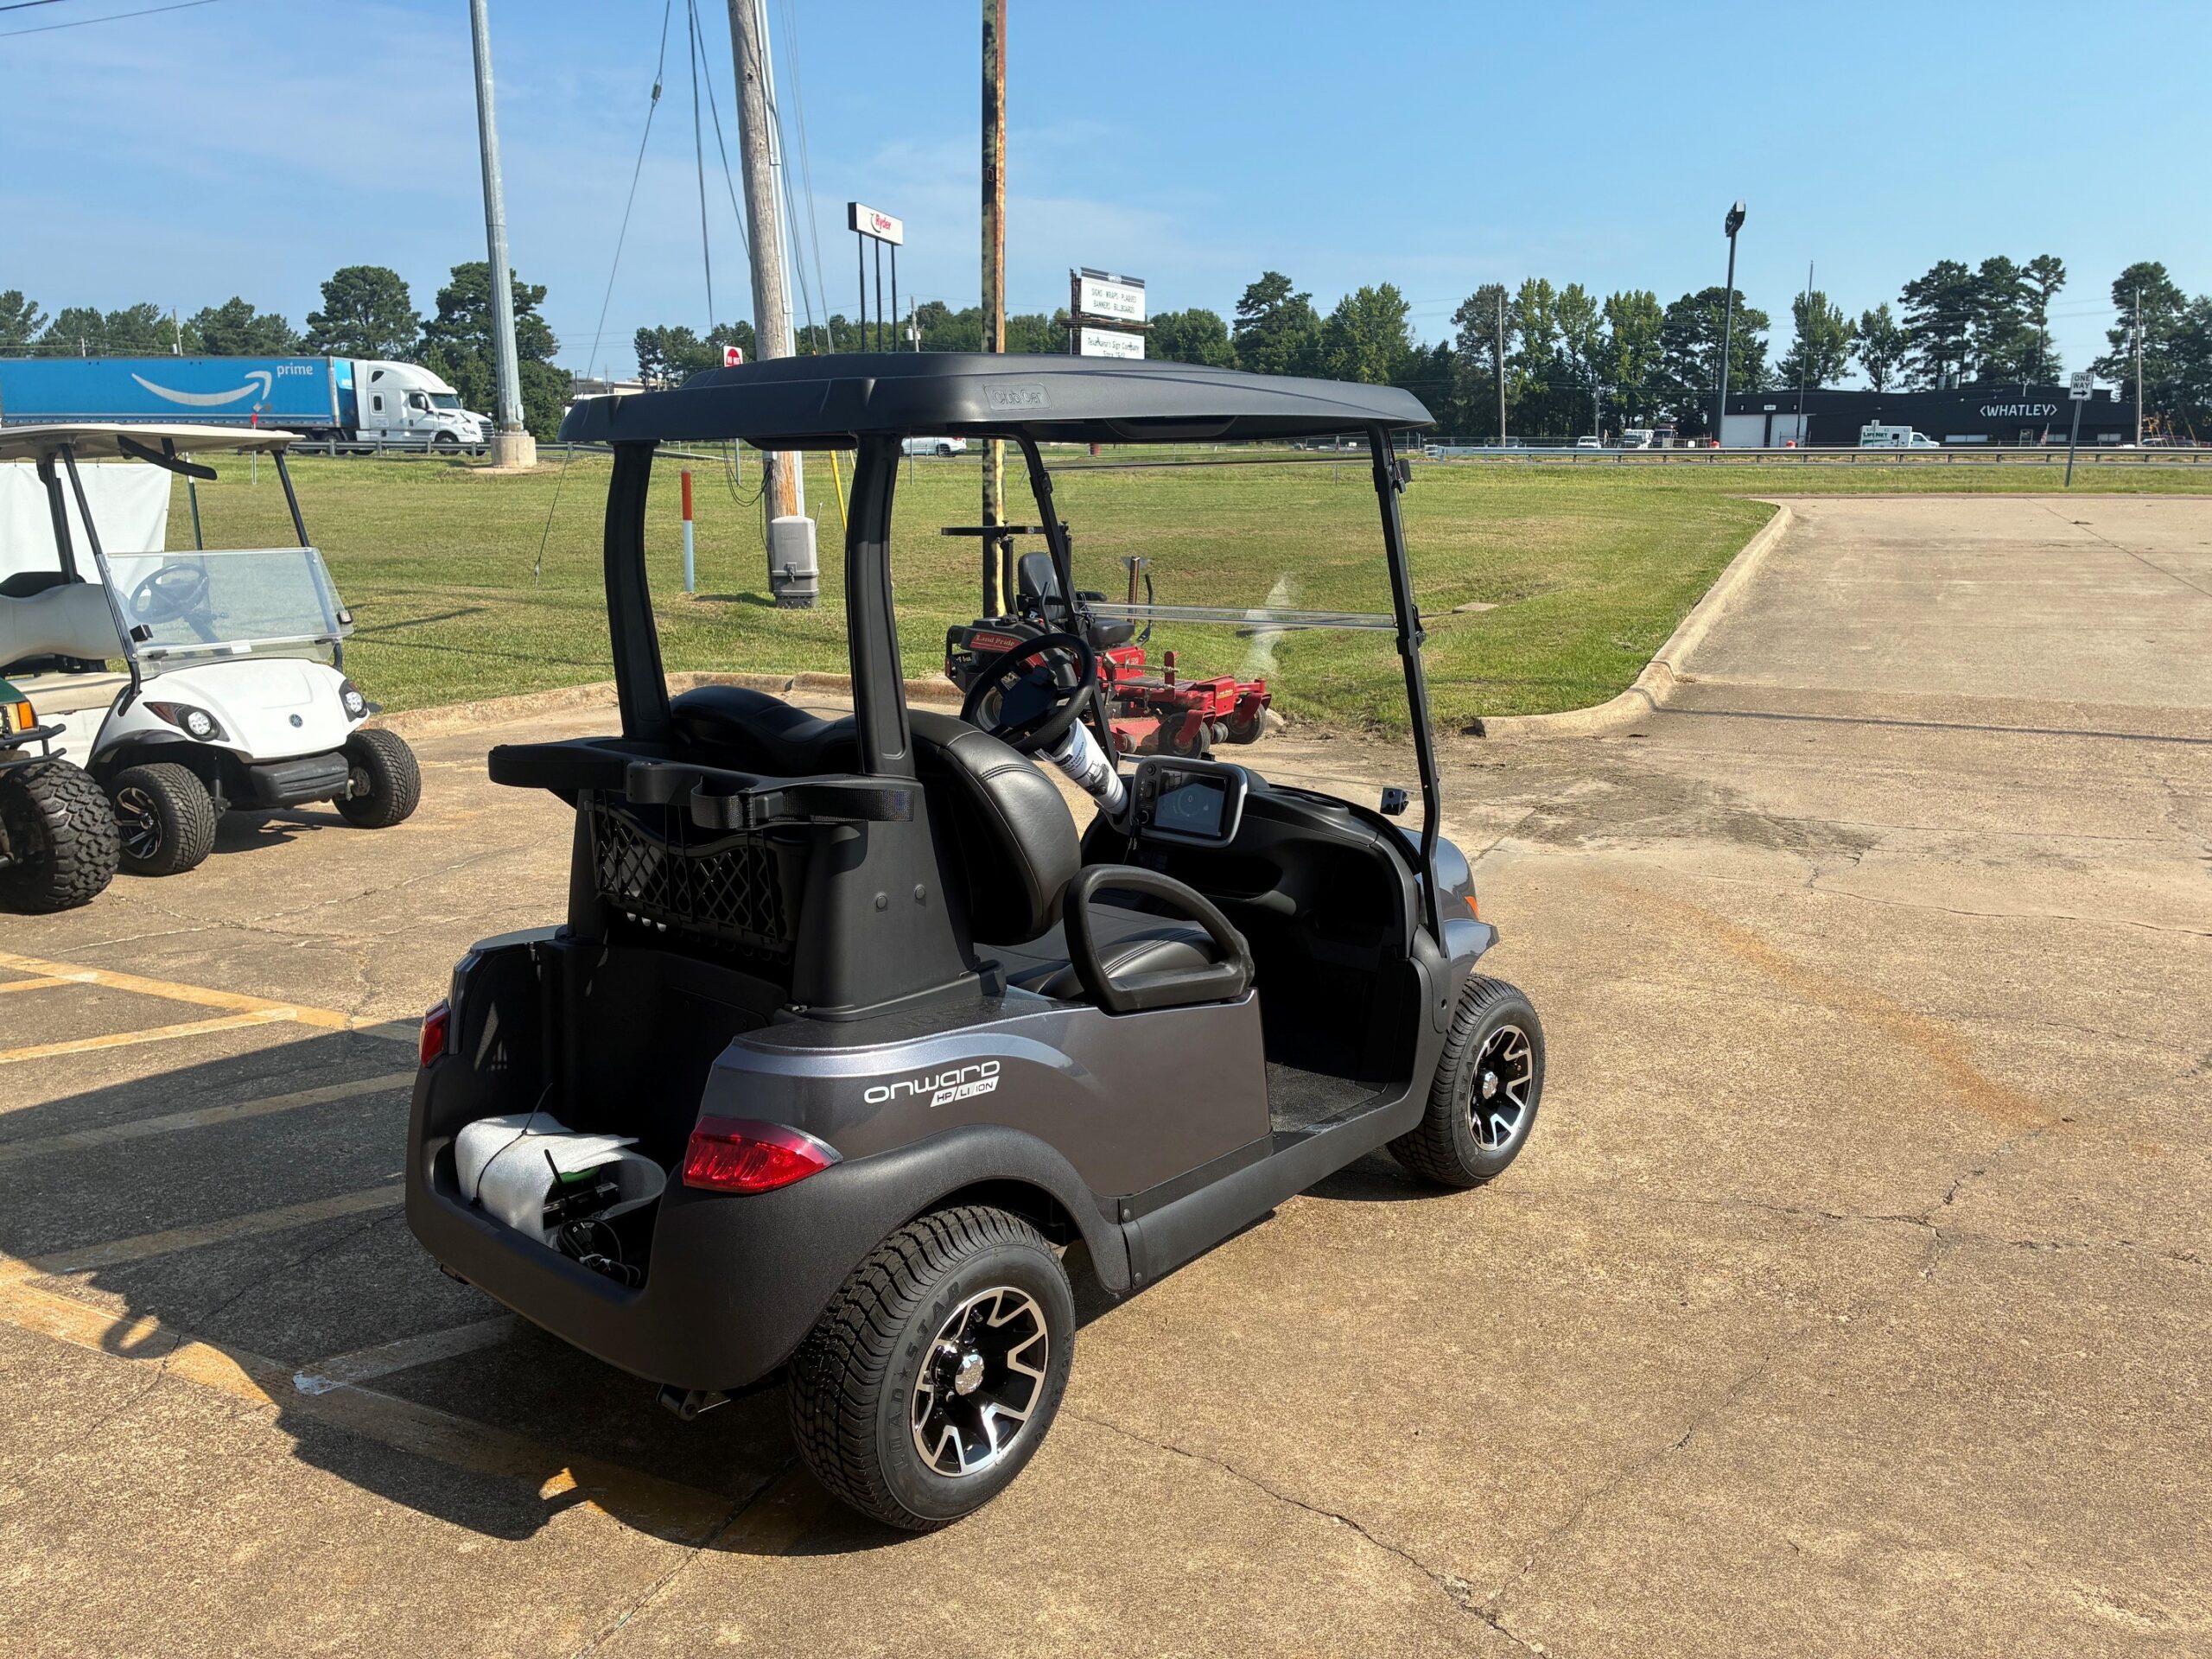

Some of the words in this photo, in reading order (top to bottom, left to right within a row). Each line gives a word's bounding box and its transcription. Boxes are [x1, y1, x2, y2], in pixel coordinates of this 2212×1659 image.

[875, 213, 891, 230] Ryder
[276, 362, 313, 378] prime
[976, 634, 994, 643] Land
[995, 638, 1014, 647] Pride
[936, 1091, 952, 1103] HP
[960, 1087, 970, 1096] LI
[976, 1081, 994, 1093] ION
[905, 1281, 962, 1363] STAR
